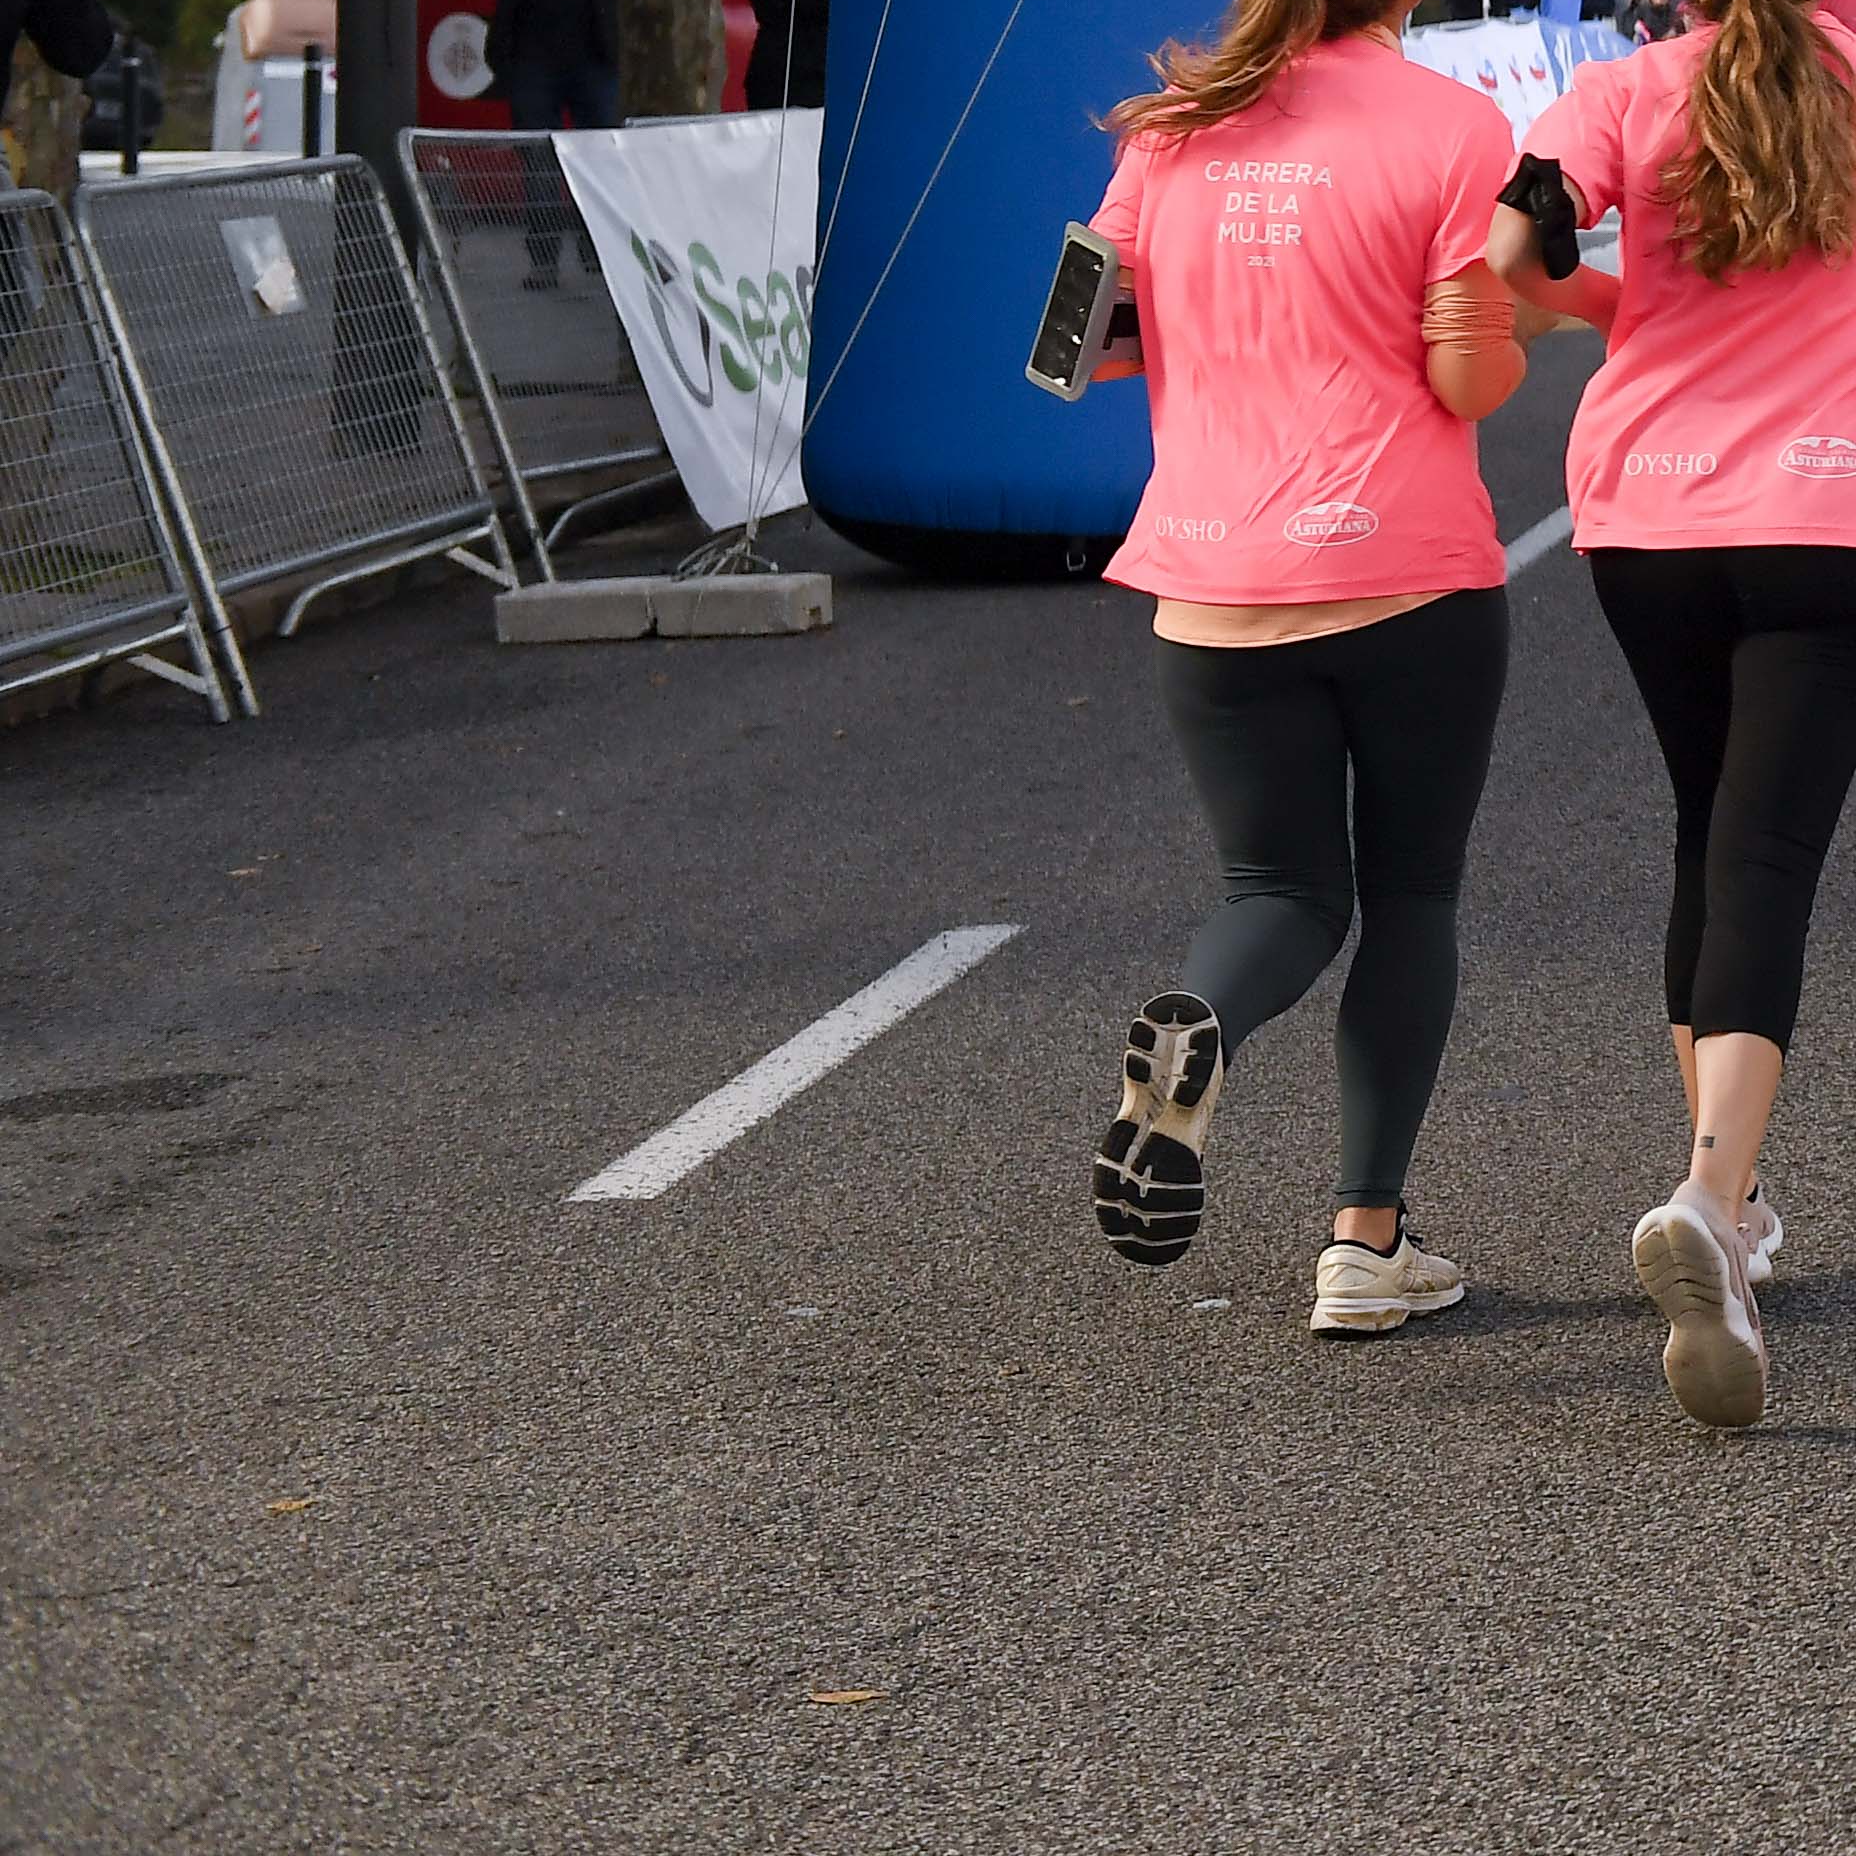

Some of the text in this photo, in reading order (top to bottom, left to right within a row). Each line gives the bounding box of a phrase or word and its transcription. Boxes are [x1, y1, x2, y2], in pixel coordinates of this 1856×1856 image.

[1204, 160, 1333, 189] CARRERA
[1224, 191, 1300, 215] DE LA
[1218, 222, 1302, 245] MUJER
[1624, 452, 1718, 476] OYSHO
[1155, 515, 1227, 543] OYSHO
